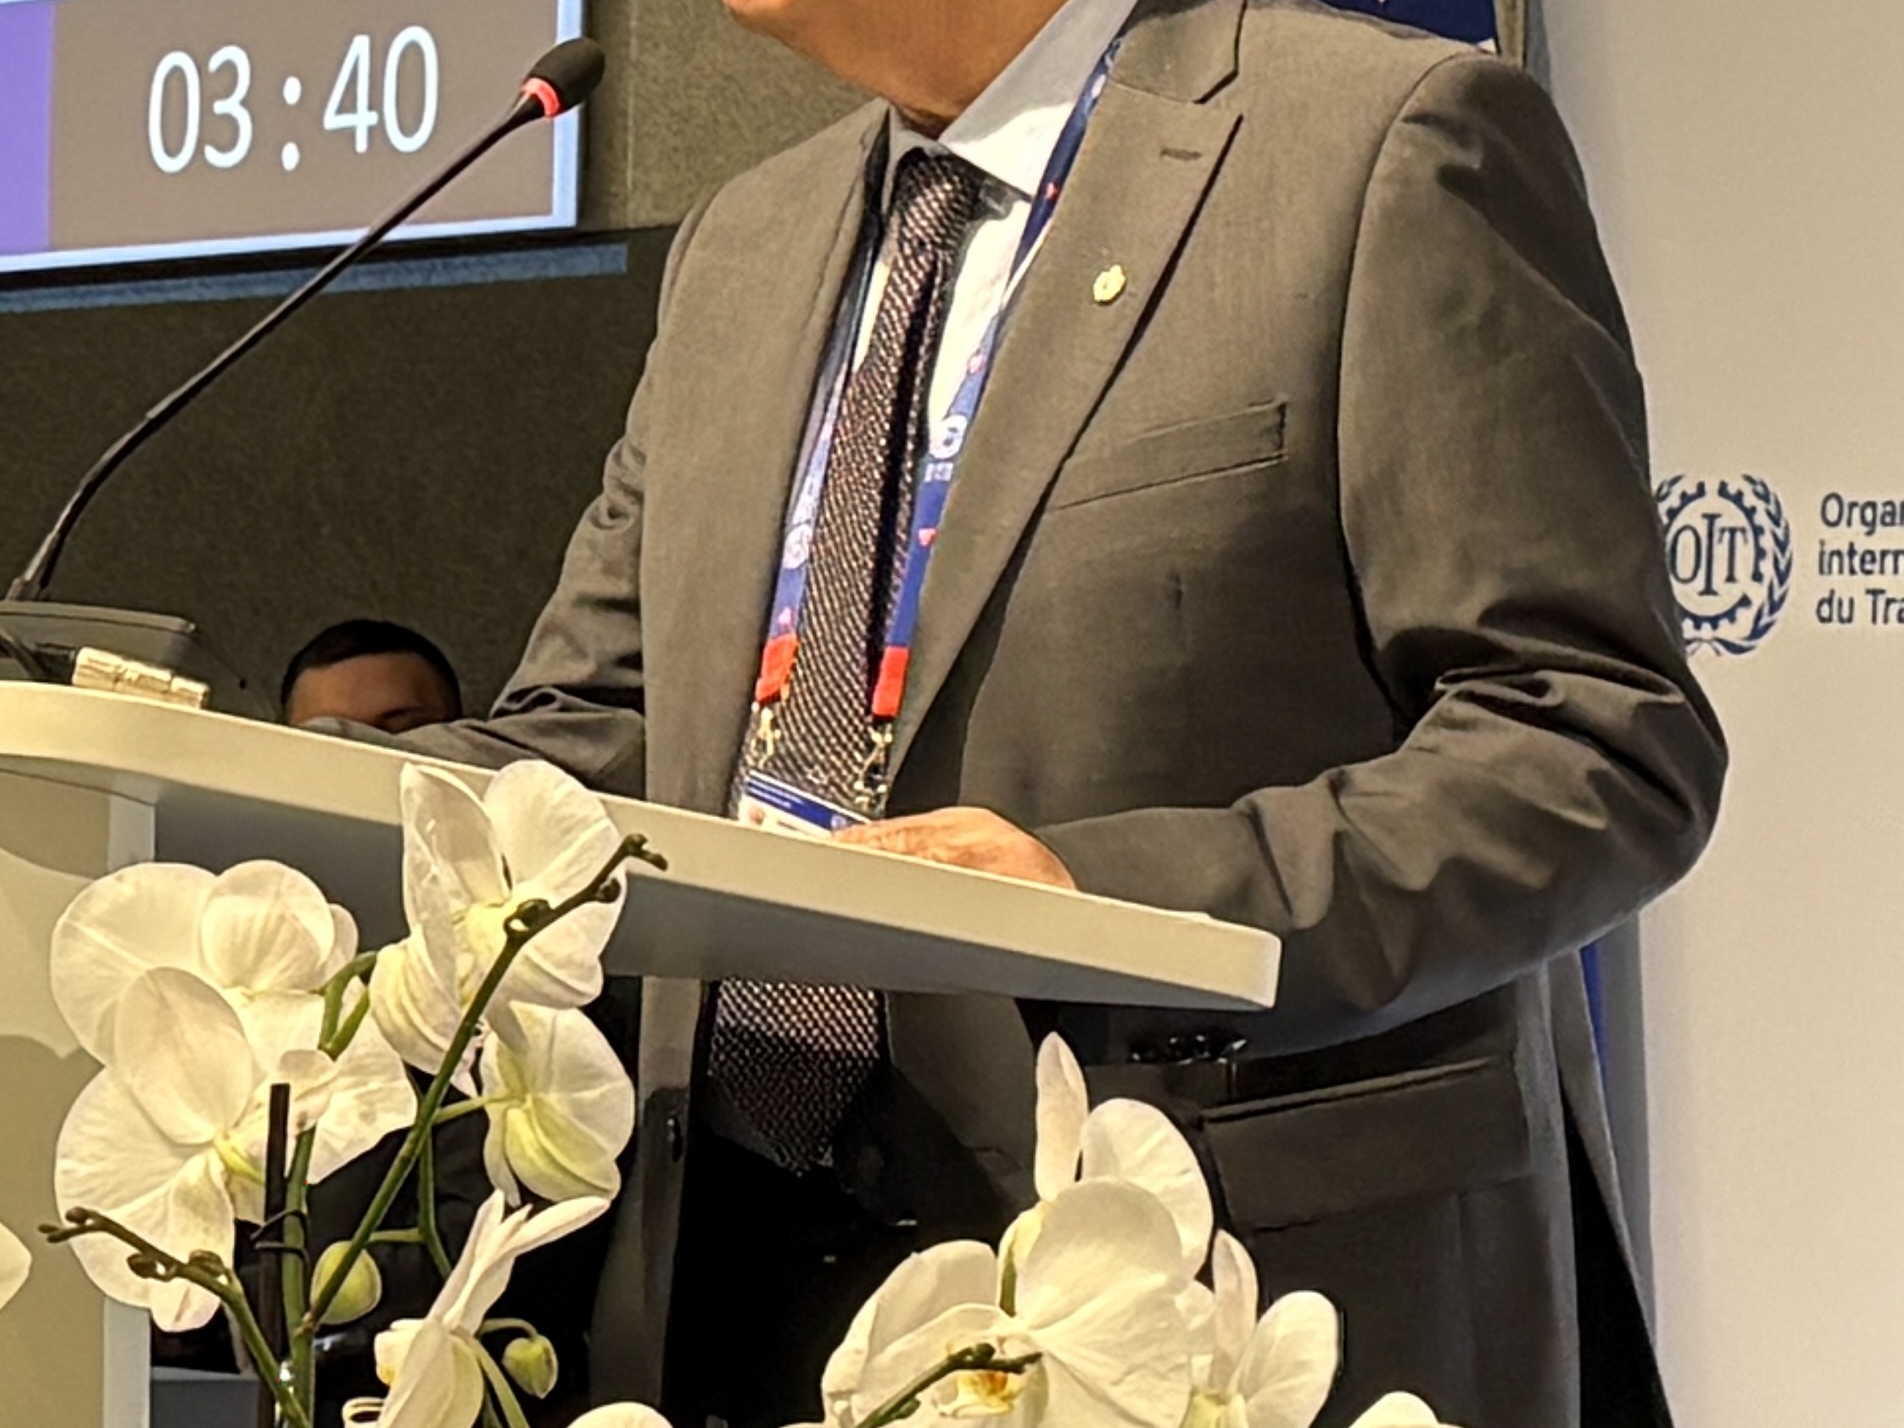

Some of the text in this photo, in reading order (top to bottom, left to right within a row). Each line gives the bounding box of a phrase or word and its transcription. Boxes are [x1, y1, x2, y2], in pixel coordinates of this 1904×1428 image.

[148, 25, 439, 173] 03:40
[1670, 513, 1747, 596] OIT
[1816, 589, 1855, 624] du
